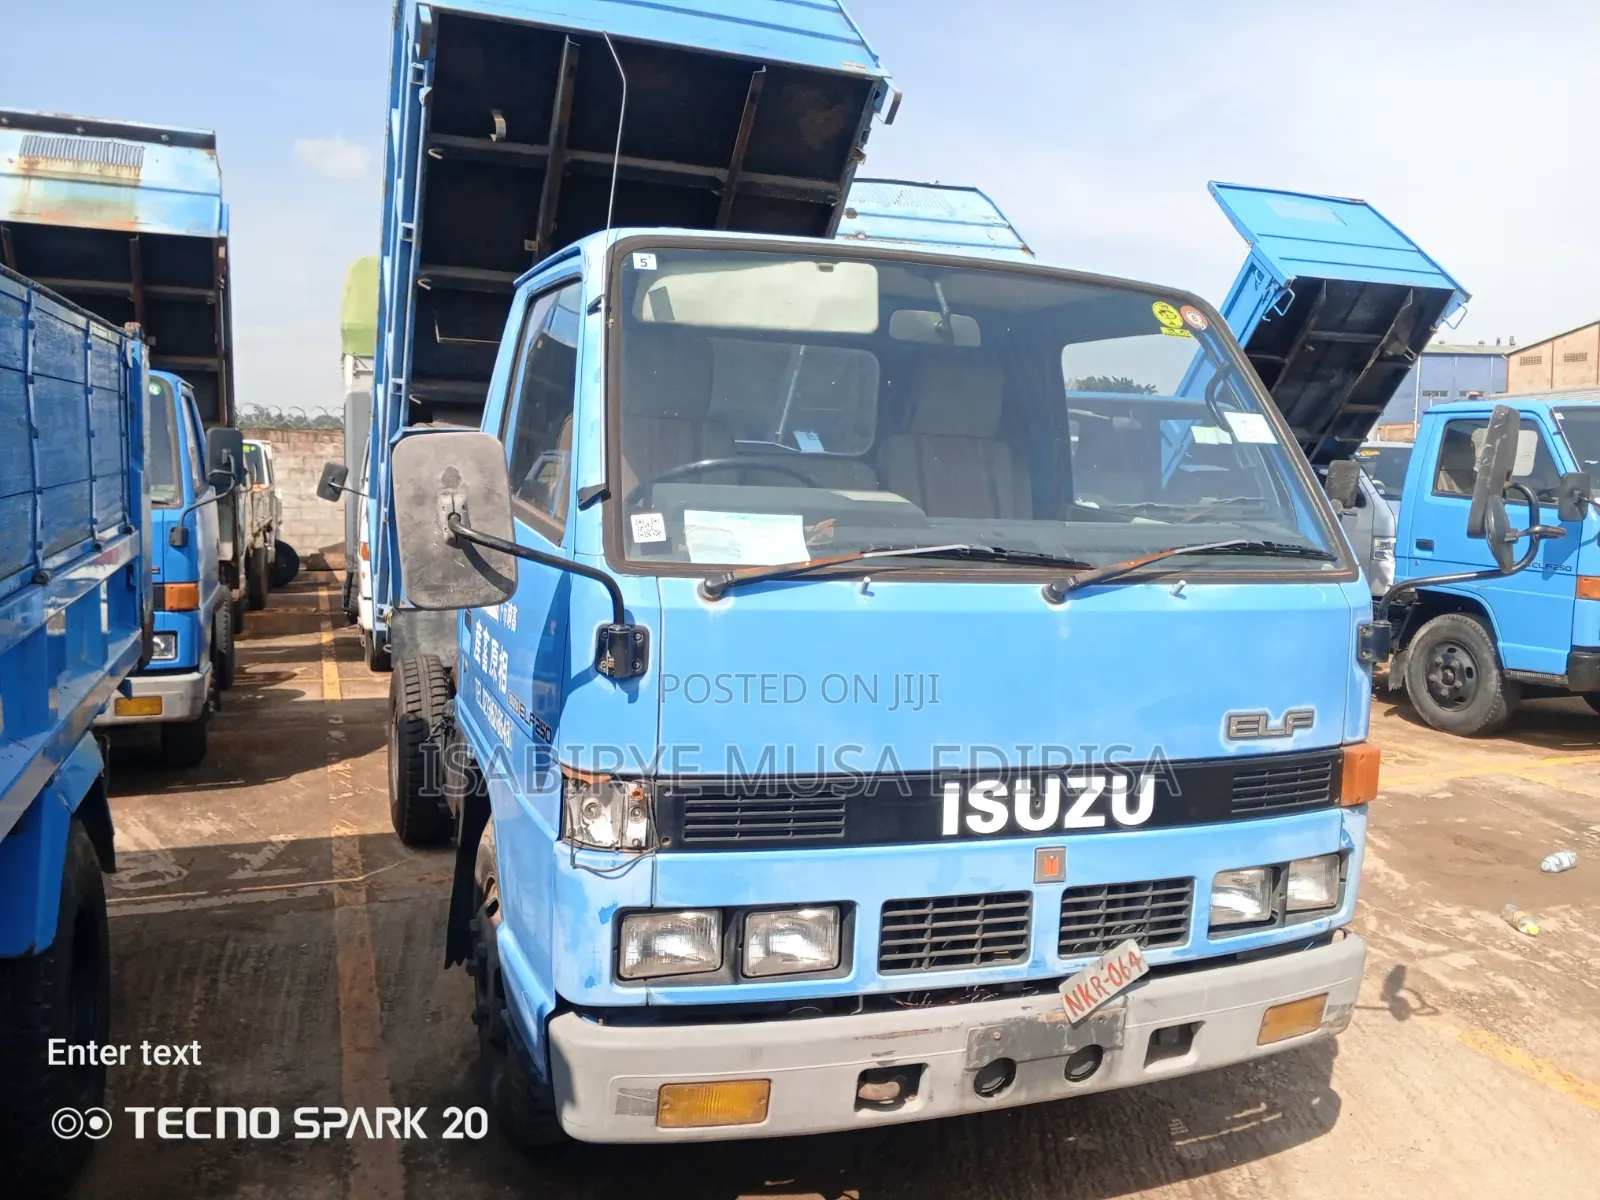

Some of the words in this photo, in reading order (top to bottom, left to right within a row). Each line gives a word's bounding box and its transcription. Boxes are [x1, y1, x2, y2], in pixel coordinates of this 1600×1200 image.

[639, 257, 649, 268] 5
[1226, 710, 1315, 741] ELF
[942, 774, 1156, 836] ISUZU
[1064, 950, 1143, 1017] NKR-064
